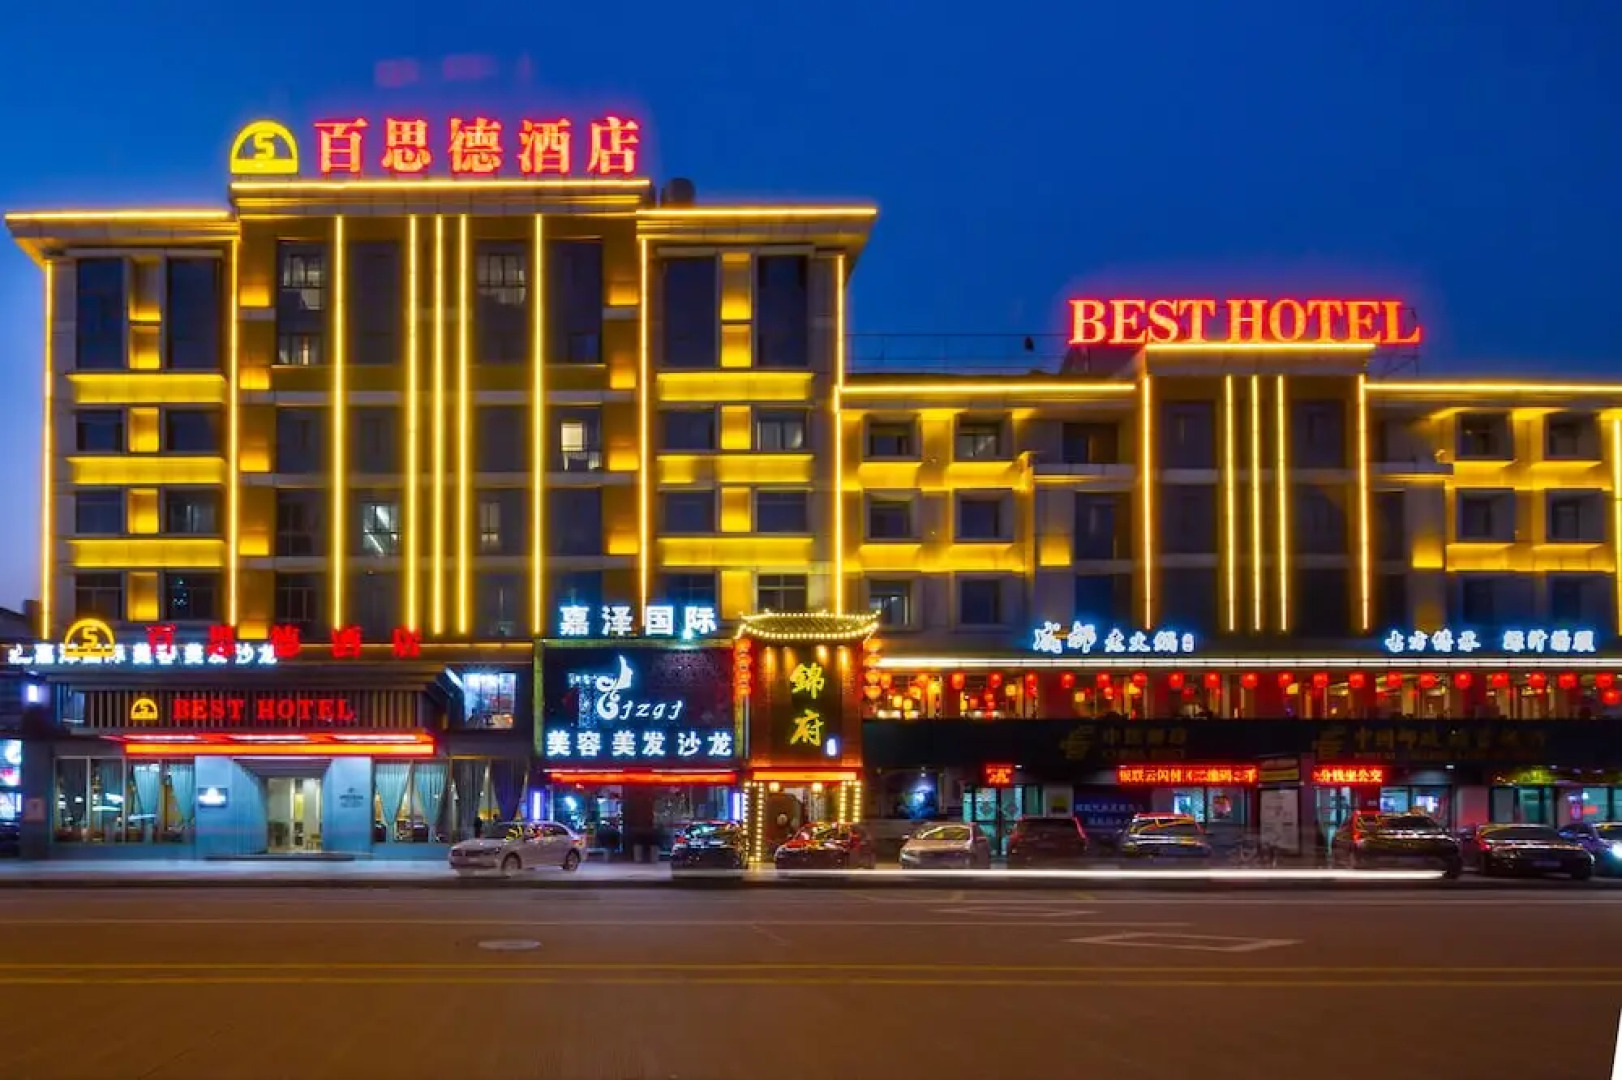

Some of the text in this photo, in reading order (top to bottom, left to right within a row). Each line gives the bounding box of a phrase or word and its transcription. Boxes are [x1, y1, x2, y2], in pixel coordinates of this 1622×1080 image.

[313, 116, 641, 174] 百思德酒店
[1067, 298, 1422, 345] BEST HOTEL
[559, 604, 718, 637] 嘉泽国际
[173, 698, 355, 721] BEST HOTEL
[546, 729, 733, 757] 美容美发沙龙
